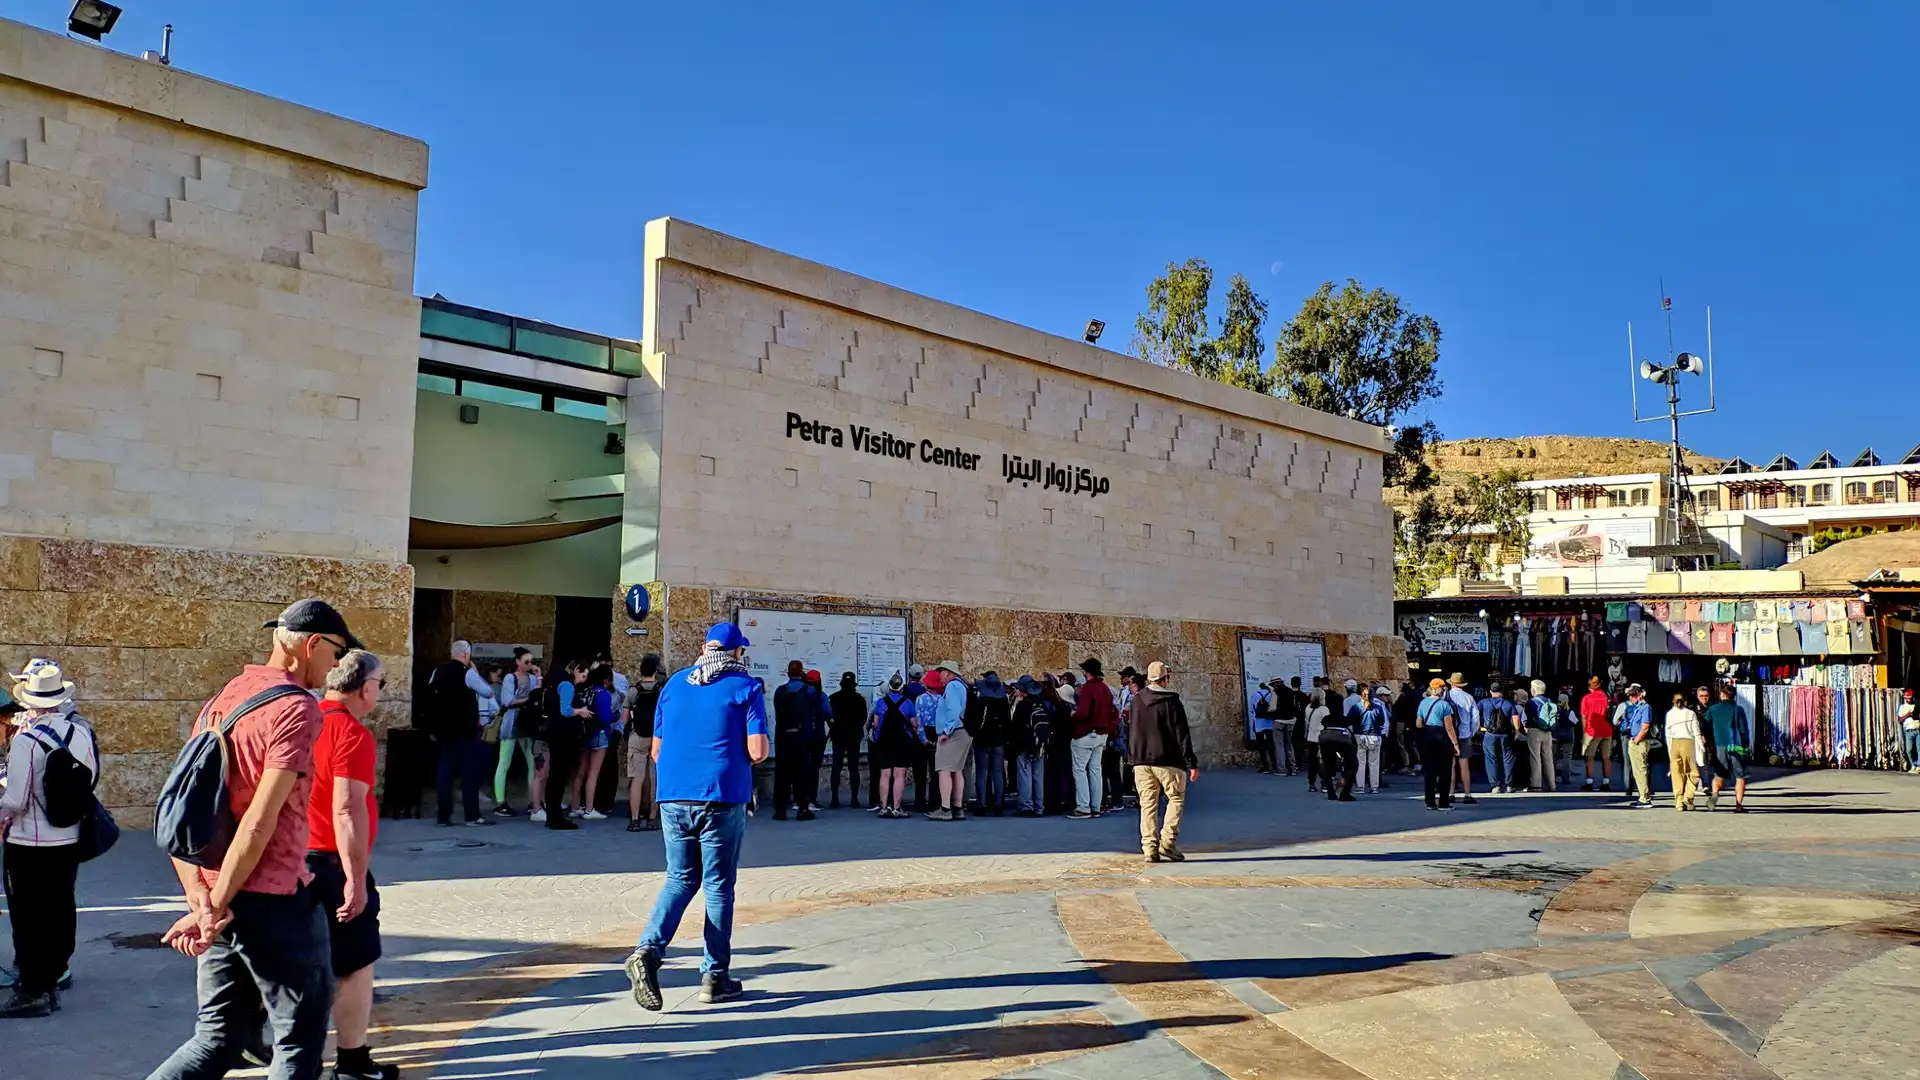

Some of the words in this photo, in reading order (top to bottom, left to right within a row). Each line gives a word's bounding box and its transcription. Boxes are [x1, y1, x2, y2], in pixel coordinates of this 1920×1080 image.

[786, 411, 843, 448] Petra
[850, 424, 916, 460] Visitor
[920, 439, 981, 471] Center
[1002, 454, 1041, 488] البترا
[1043, 462, 1072, 493] زوار
[1074, 467, 1109, 498] مركز
[1437, 626, 1459, 635] SNACKS
[1460, 626, 1475, 635] SHOP
[753, 662, 769, 670] Petra
